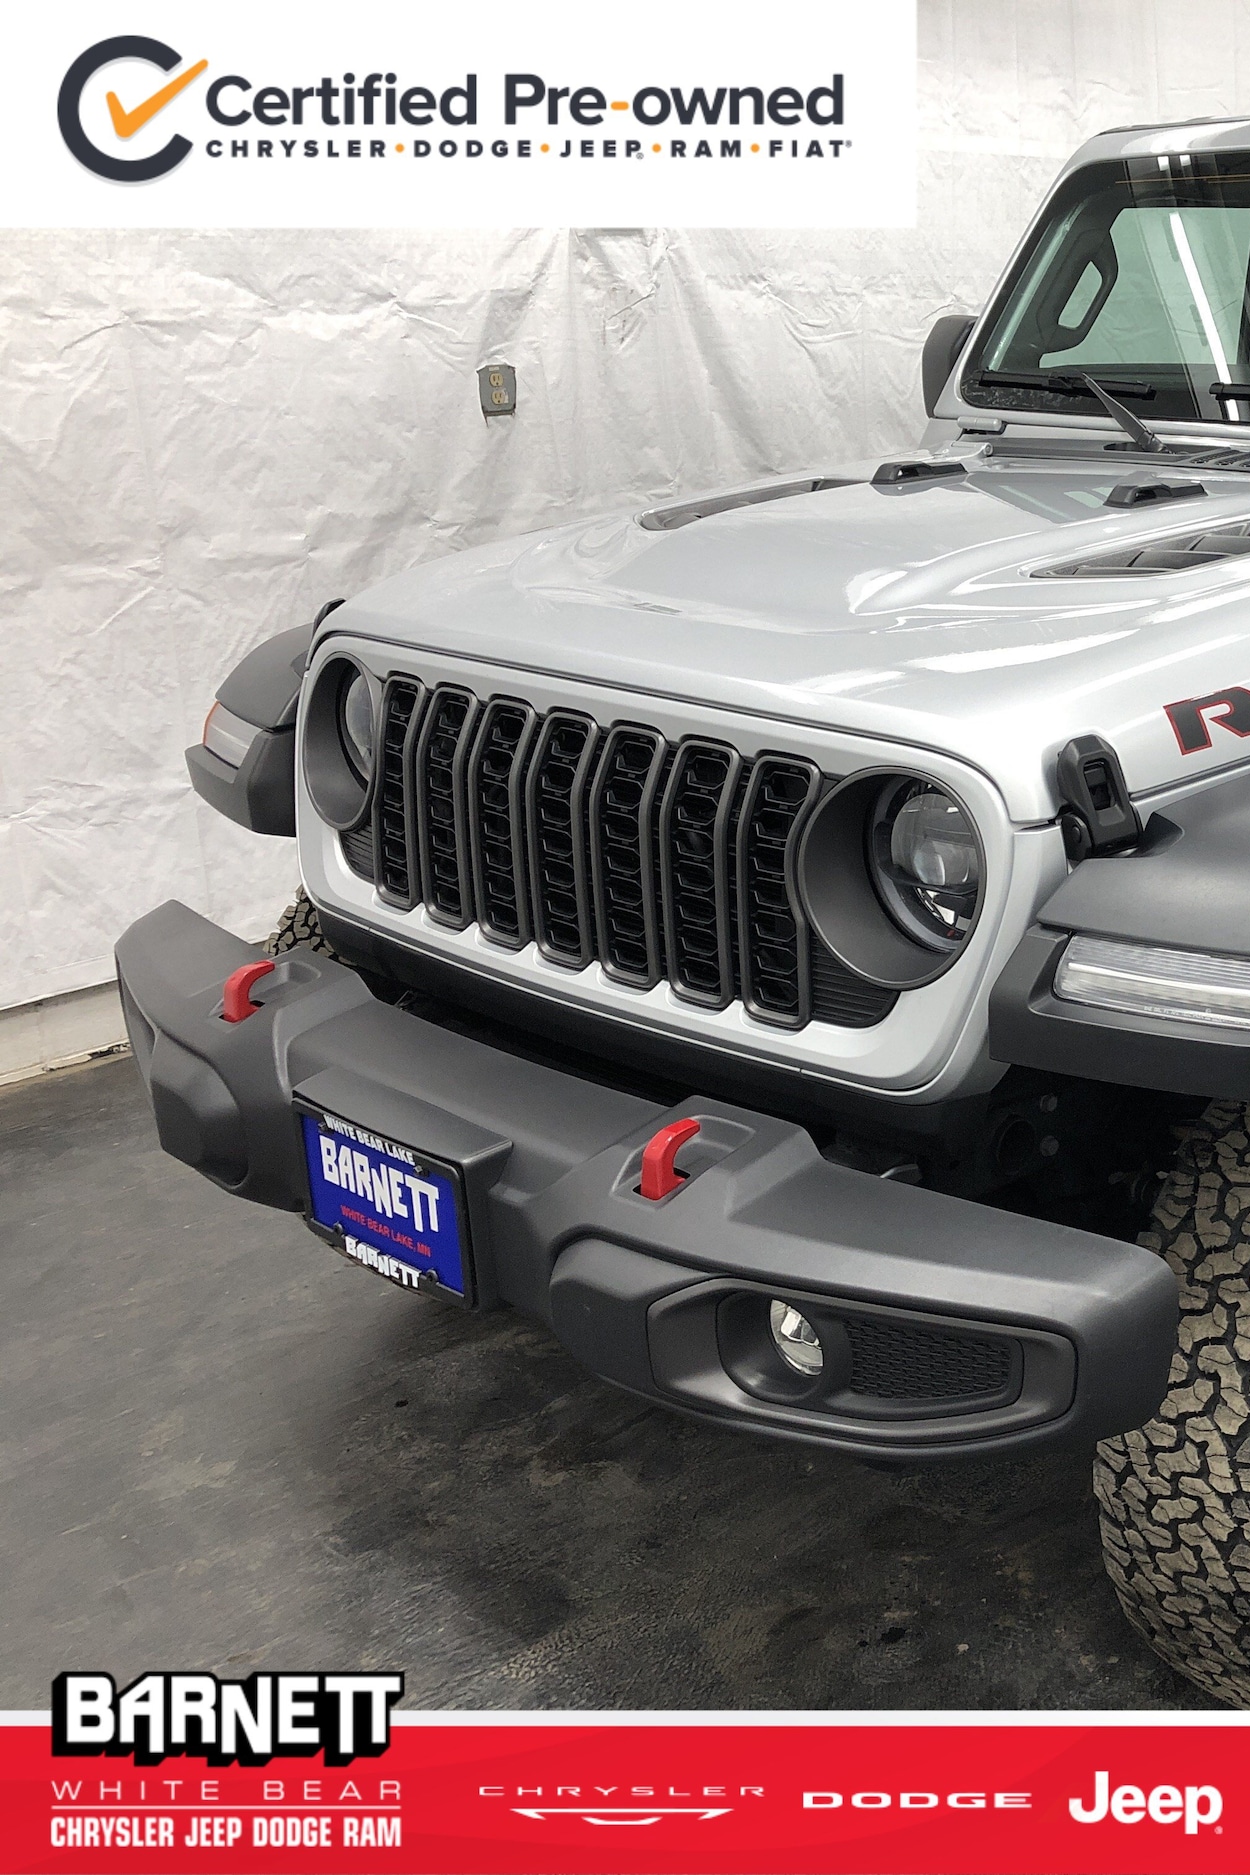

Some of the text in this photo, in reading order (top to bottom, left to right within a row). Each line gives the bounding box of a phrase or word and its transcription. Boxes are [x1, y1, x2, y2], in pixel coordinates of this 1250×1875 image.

[324, 1115, 415, 1166] WHITE BEAR LAKE
[319, 1135, 440, 1233] BARNETT
[341, 1205, 366, 1226] WHITE
[367, 1216, 391, 1240] BEAR
[417, 1240, 431, 1257] MN
[345, 1236, 421, 1288] BARNETT
